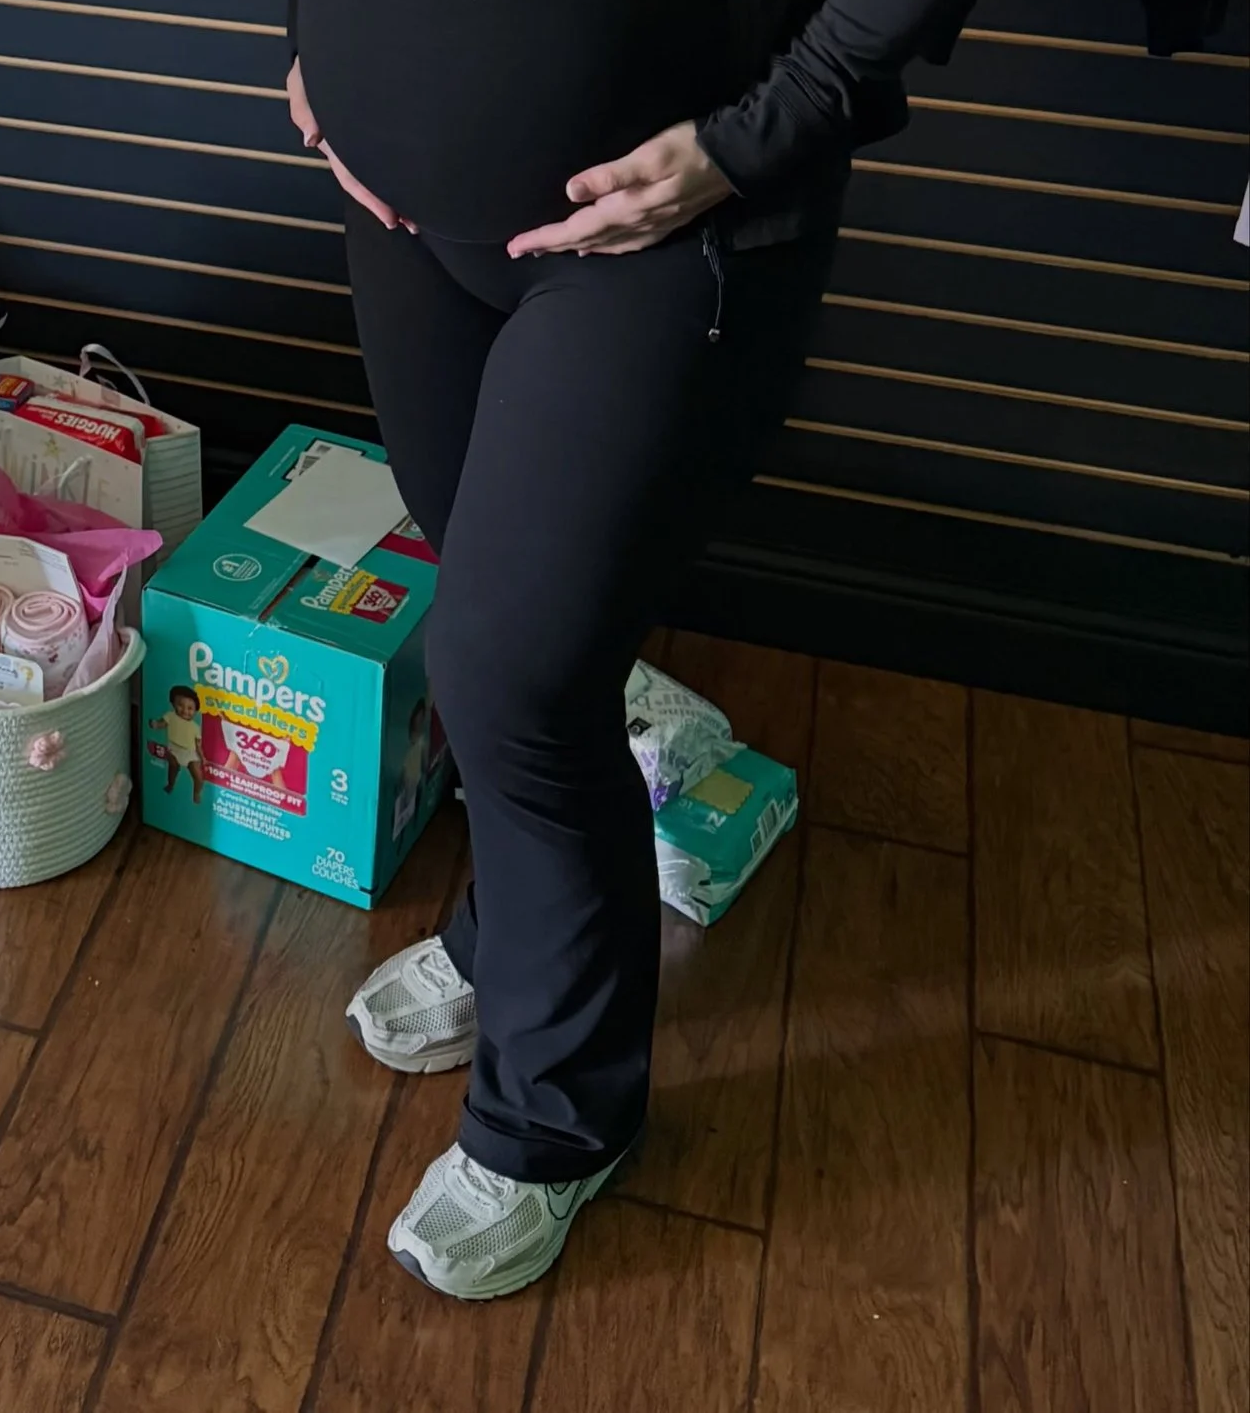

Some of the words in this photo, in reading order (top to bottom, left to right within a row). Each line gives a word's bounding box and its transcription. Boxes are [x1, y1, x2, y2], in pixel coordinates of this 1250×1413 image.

[55, 413, 121, 442] HUGGIES
[189, 641, 326, 724] Pampers
[204, 696, 308, 740] swaddlers
[229, 774, 287, 801] LEAKPROOF
[287, 795, 303, 808] FIT
[330, 768, 349, 793] 3
[216, 796, 278, 825] AJUSTEMENT
[315, 855, 355, 878] DIAPERS
[326, 846, 346, 863] 70
[311, 864, 360, 890] COUCHES
